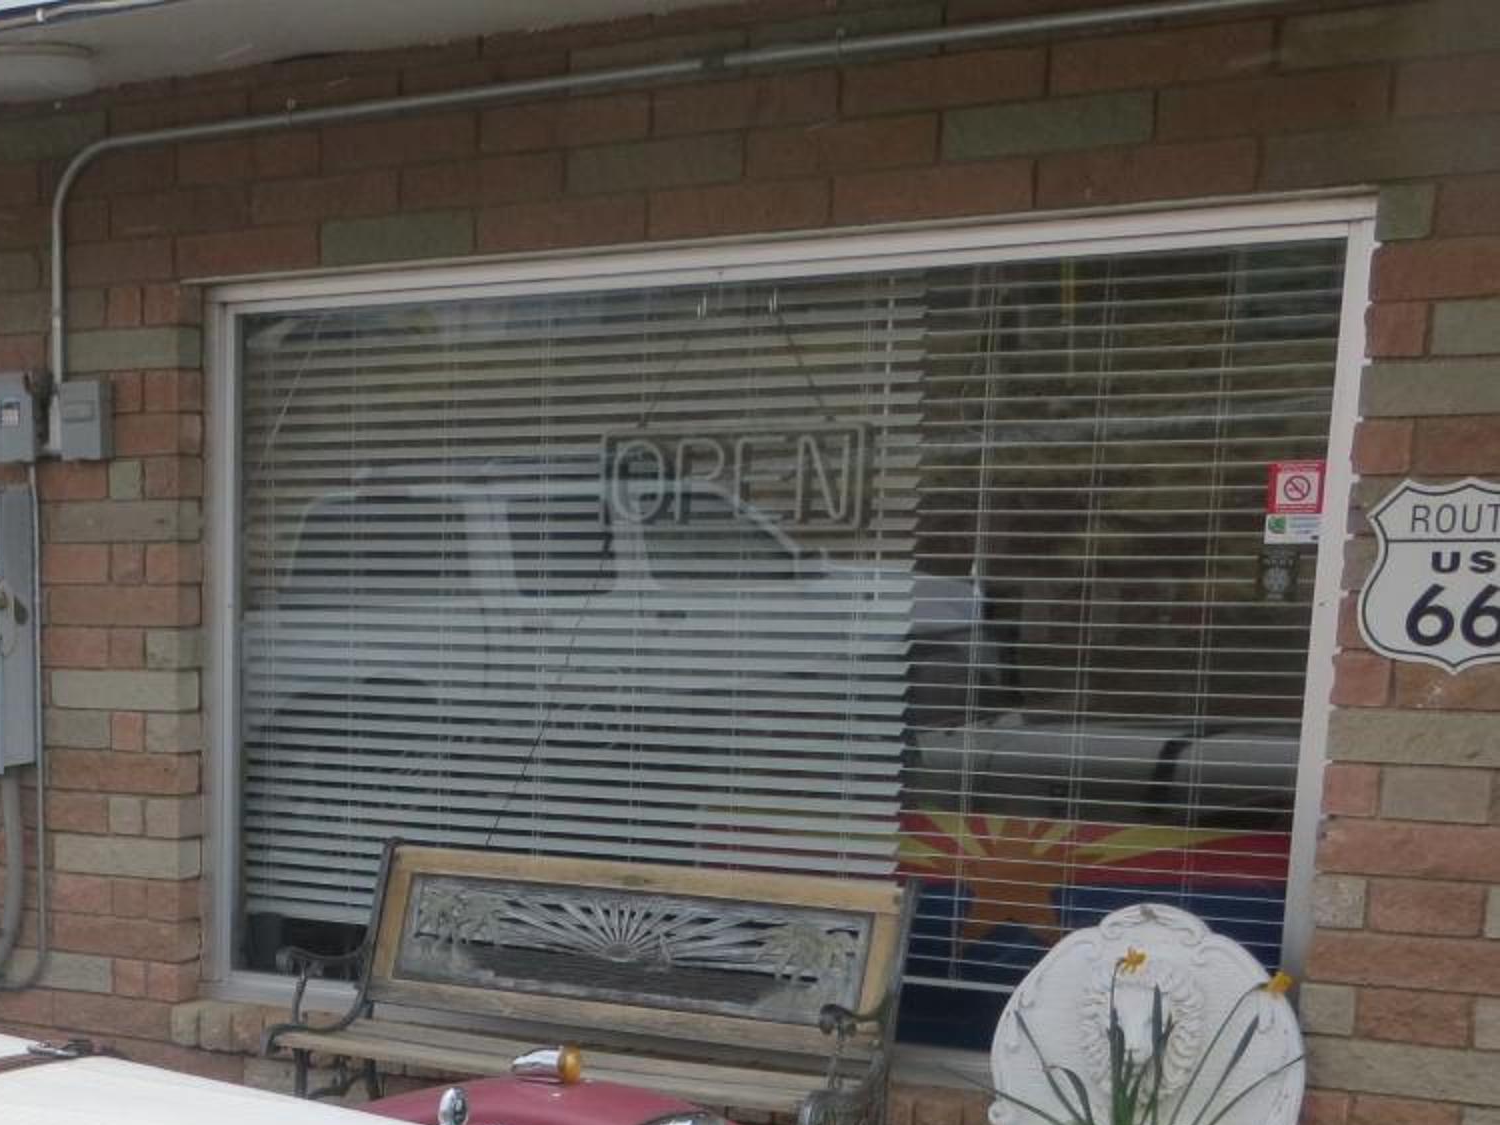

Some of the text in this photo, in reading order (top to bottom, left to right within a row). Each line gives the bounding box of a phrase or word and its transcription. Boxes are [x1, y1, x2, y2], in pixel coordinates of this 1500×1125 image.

[612, 433, 852, 524] OPEN
[1431, 550, 1496, 574] US
[1405, 584, 1500, 648] 66
